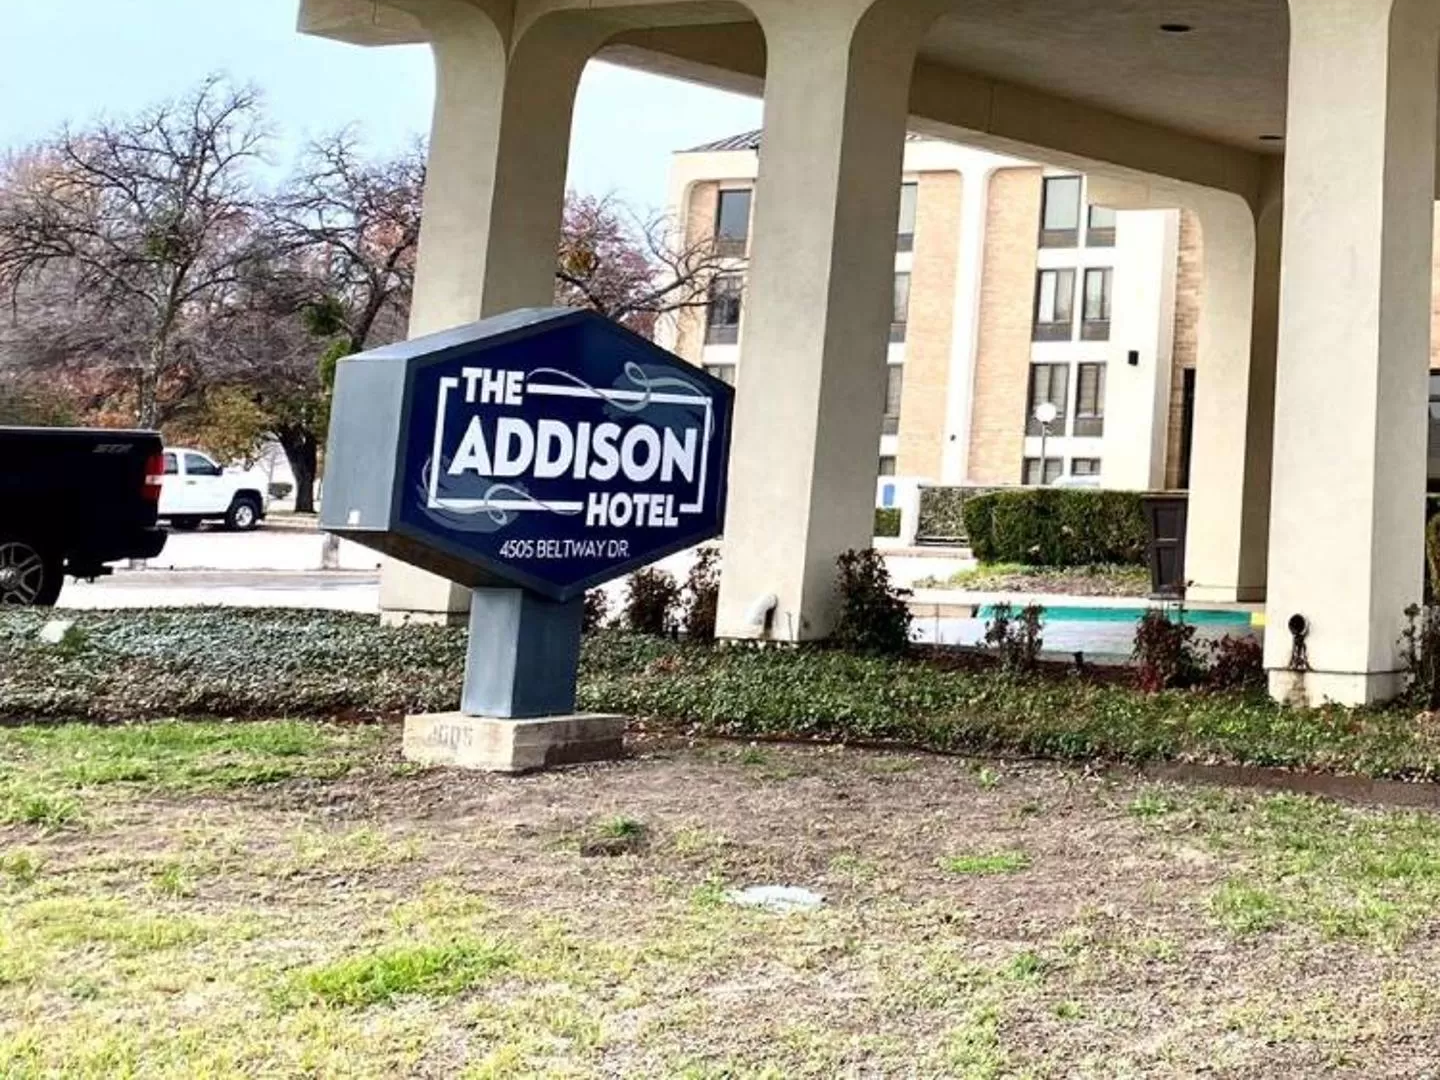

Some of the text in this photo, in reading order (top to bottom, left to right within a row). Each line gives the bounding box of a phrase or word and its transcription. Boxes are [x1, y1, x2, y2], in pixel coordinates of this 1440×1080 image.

[461, 367, 525, 405] THE
[448, 415, 698, 483] ADDISON
[585, 492, 679, 528] HOTEL
[499, 539, 630, 559] 4505 BELTWAY DR.
